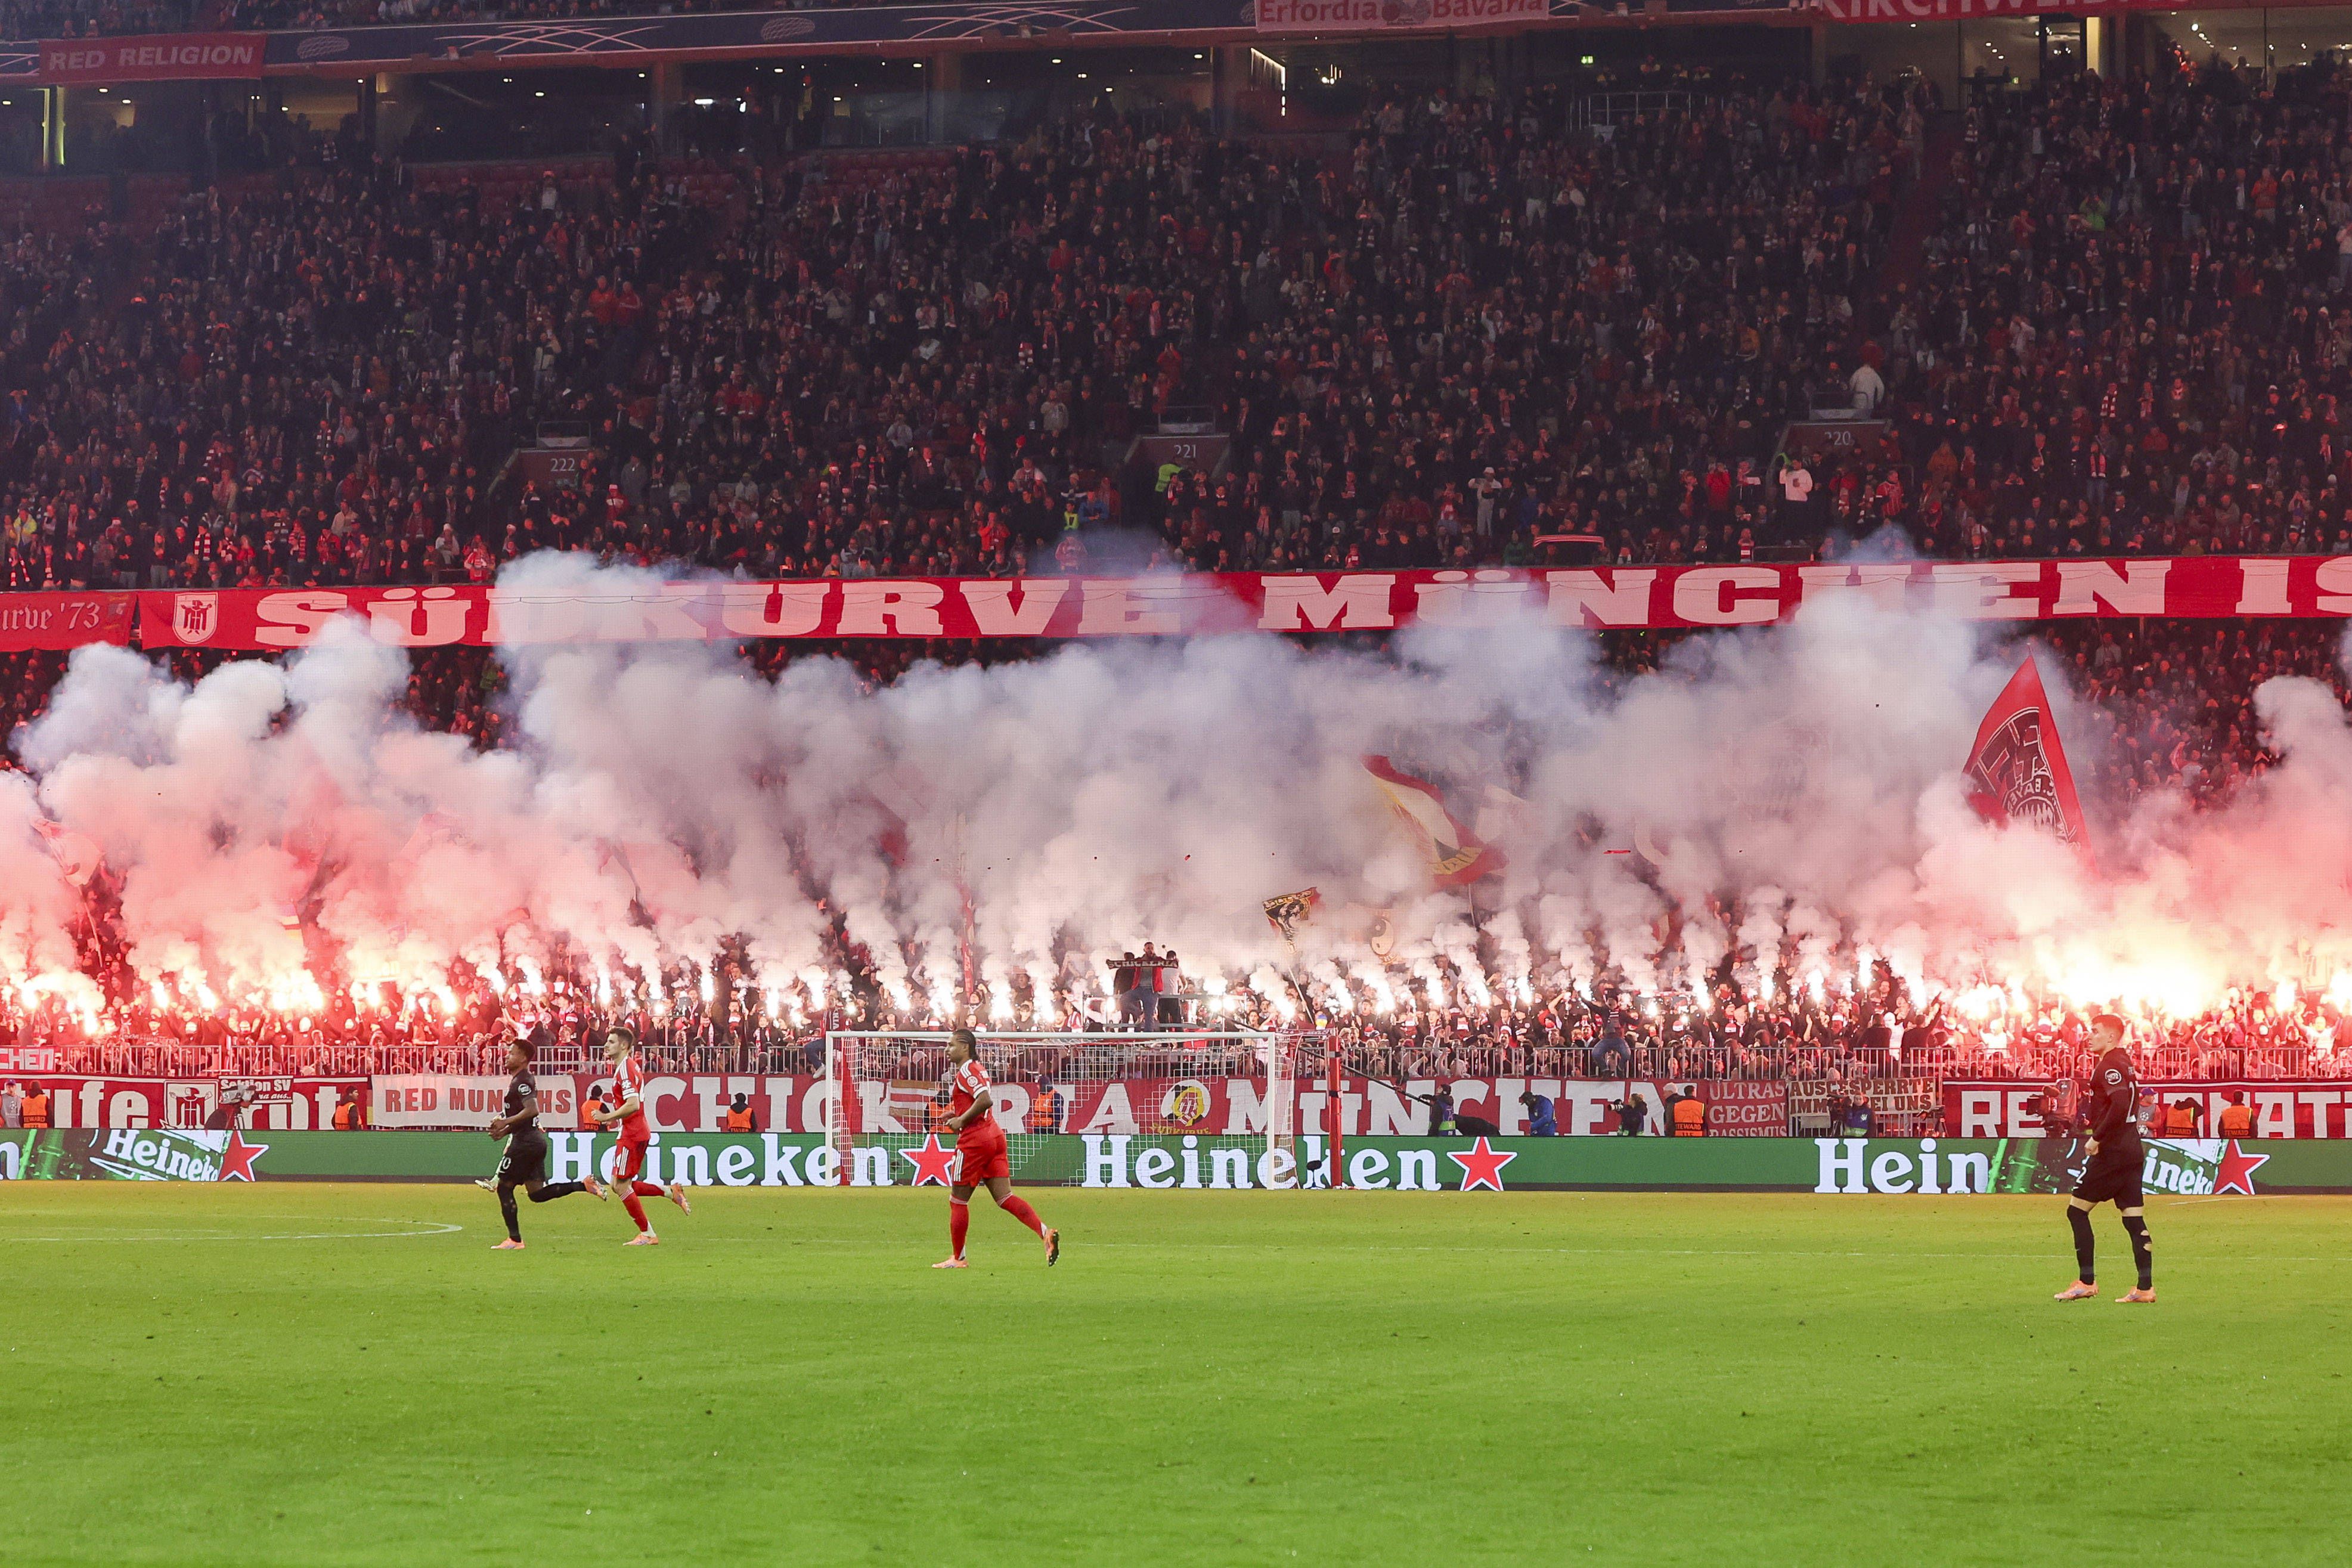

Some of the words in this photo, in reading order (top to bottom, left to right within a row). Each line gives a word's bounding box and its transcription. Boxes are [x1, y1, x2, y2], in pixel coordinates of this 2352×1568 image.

[49, 51, 106, 70] RED
[120, 45, 253, 66] RELIGION
[550, 457, 576, 472] 222
[60, 602, 100, 630] '73
[274, 1079, 292, 1091] SV
[1709, 1080, 1784, 1101] ULTRAS
[385, 1088, 437, 1113] RED
[449, 1087, 572, 1114] MUNHS
[1894, 1095, 1932, 1111] UNS
[1709, 1102, 1786, 1124] GEGEN
[1081, 1135, 1442, 1190] Heineken
[1814, 1138, 1989, 1194] Hein
